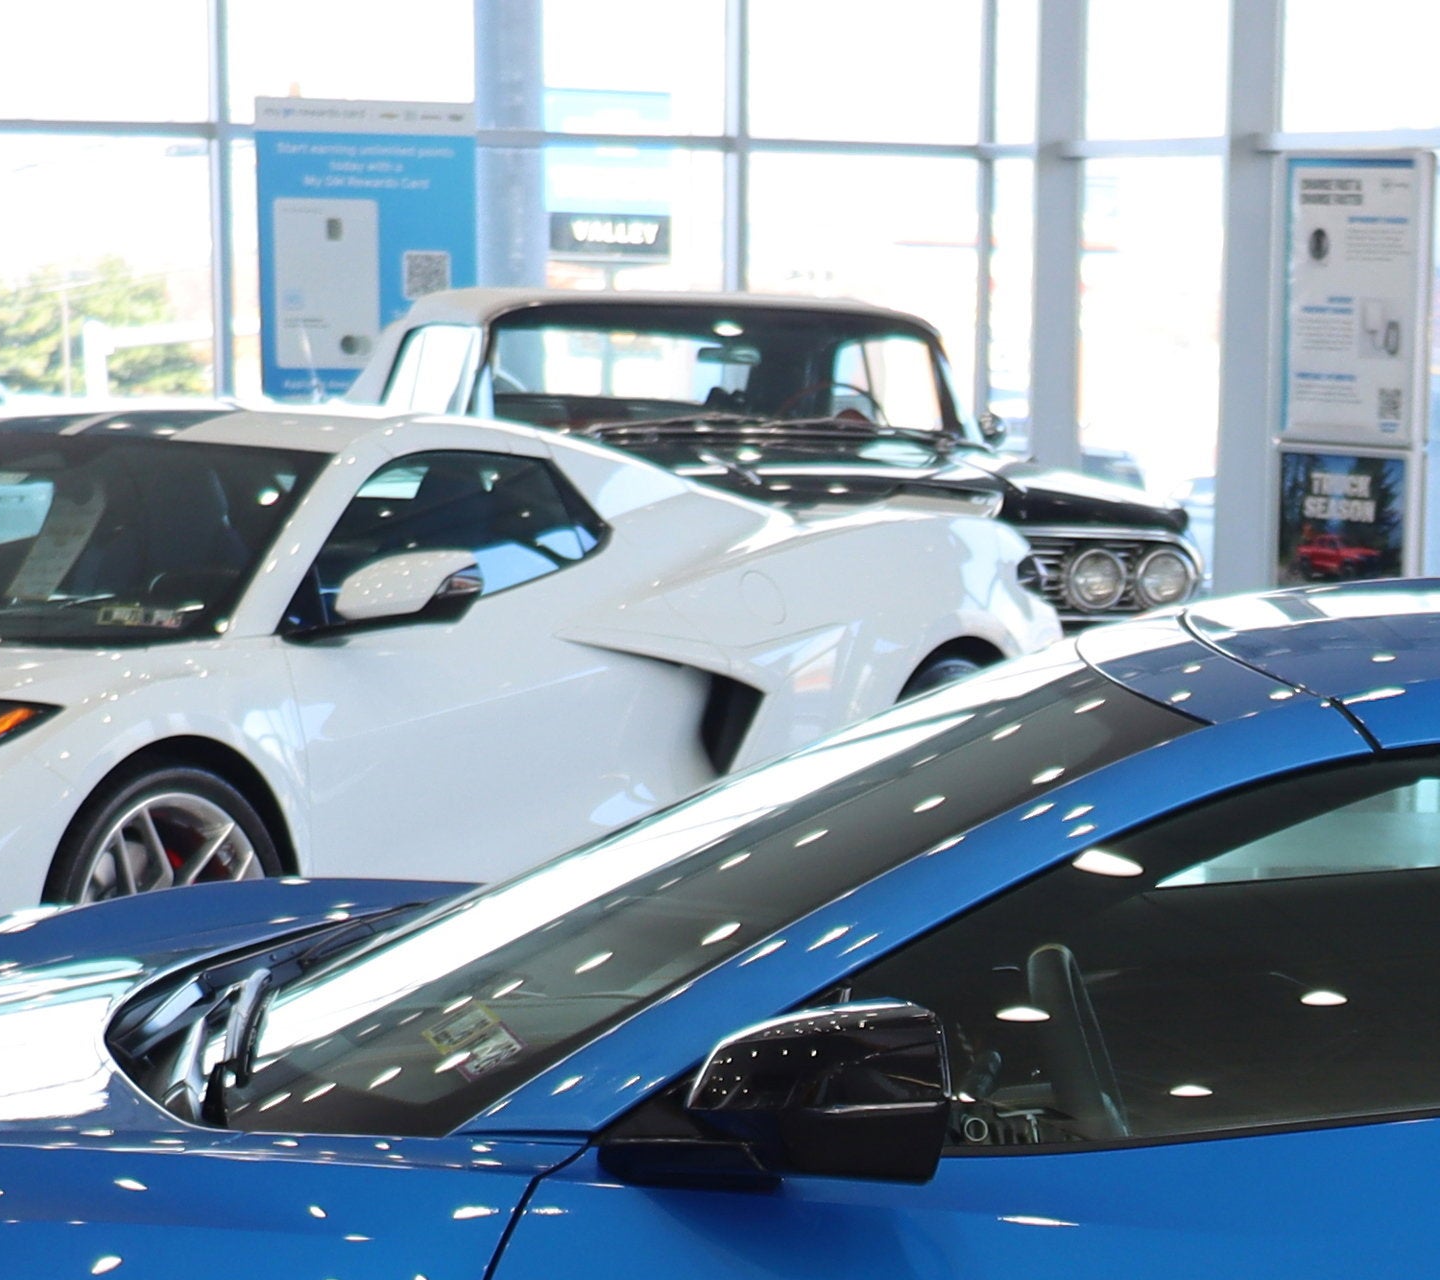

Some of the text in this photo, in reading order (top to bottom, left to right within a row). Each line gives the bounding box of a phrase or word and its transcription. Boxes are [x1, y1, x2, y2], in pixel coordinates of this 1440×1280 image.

[572, 218, 659, 246] VALLEY
[1310, 471, 1372, 498] TRUCK
[1303, 496, 1376, 523] SEASON
